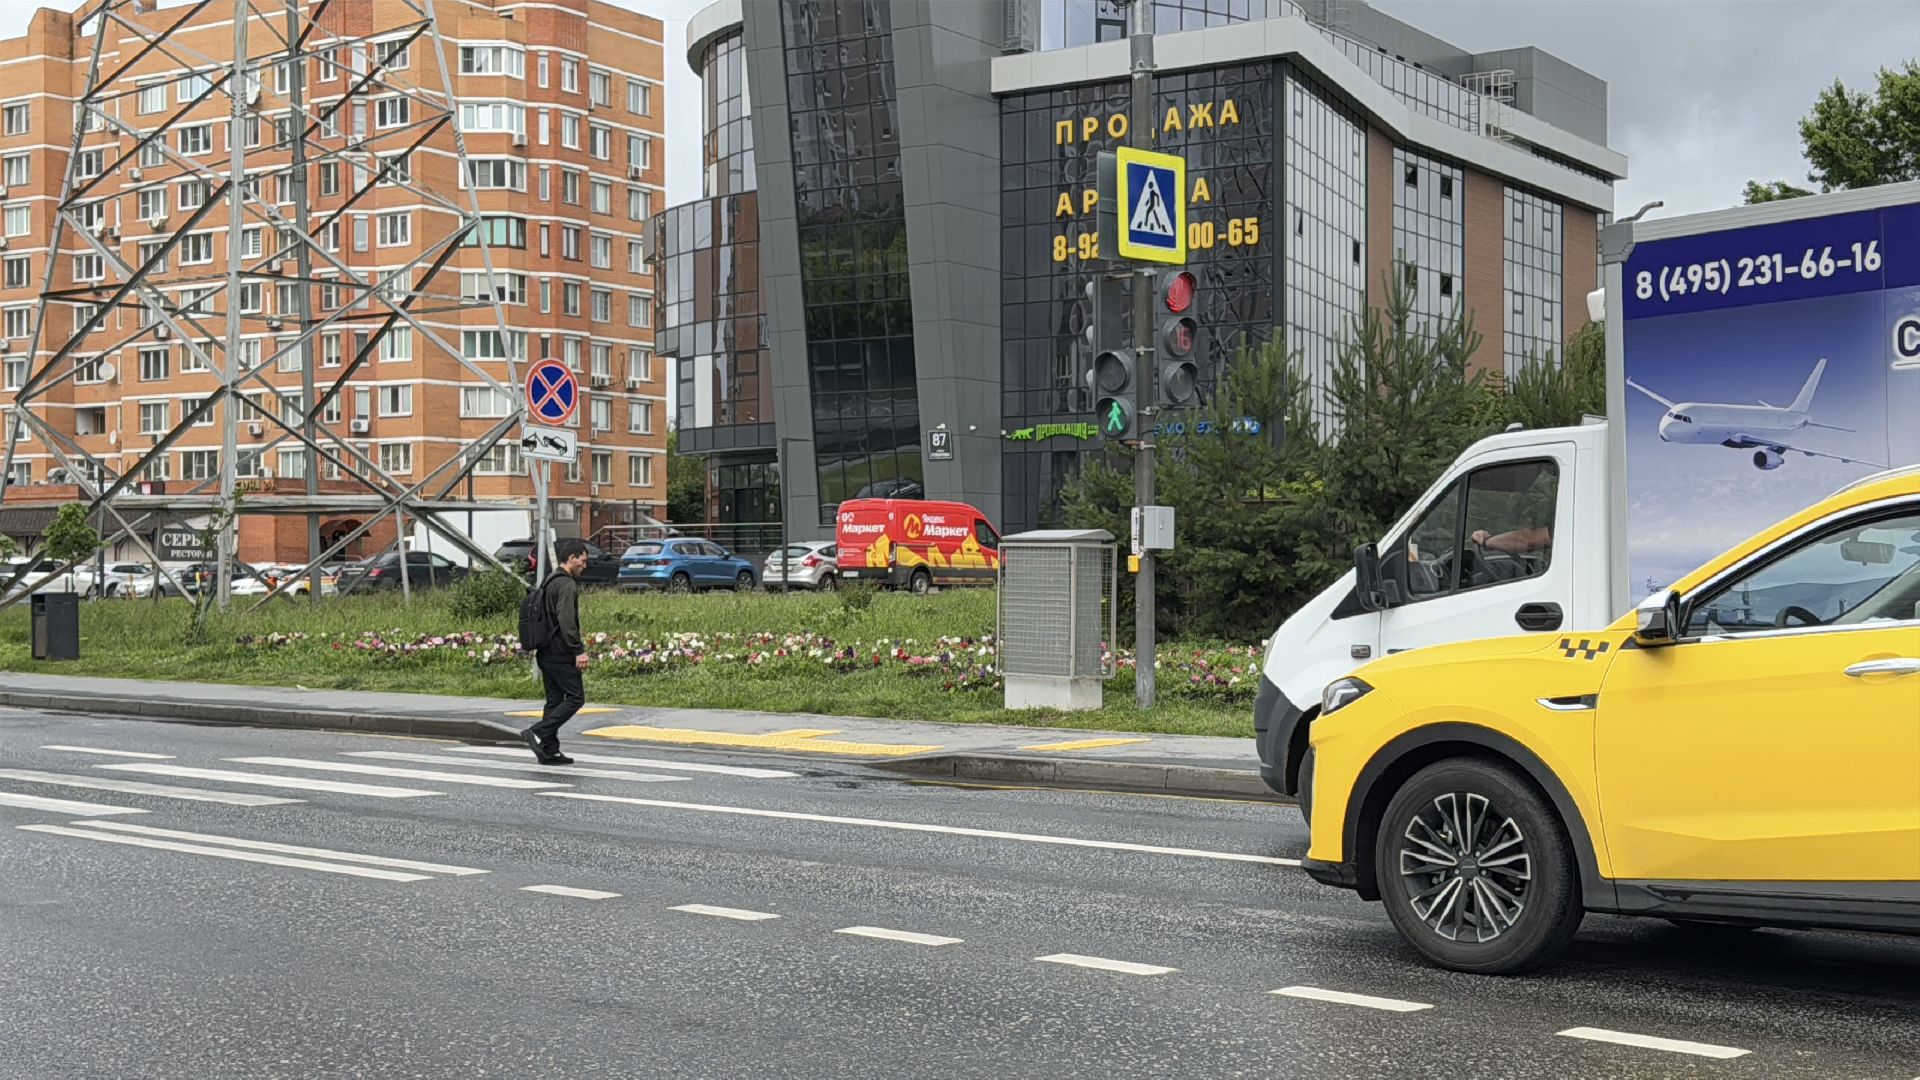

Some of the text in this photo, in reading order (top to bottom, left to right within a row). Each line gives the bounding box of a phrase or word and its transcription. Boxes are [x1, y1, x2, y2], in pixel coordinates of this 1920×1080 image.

[1055, 99, 1239, 145] ПРОАЖА
[1636, 240, 1882, 302] 8 (495) 231-66-16
[932, 433, 946, 447] 87
[842, 523, 886, 535] Маркет
[922, 524, 969, 538] Маркет
